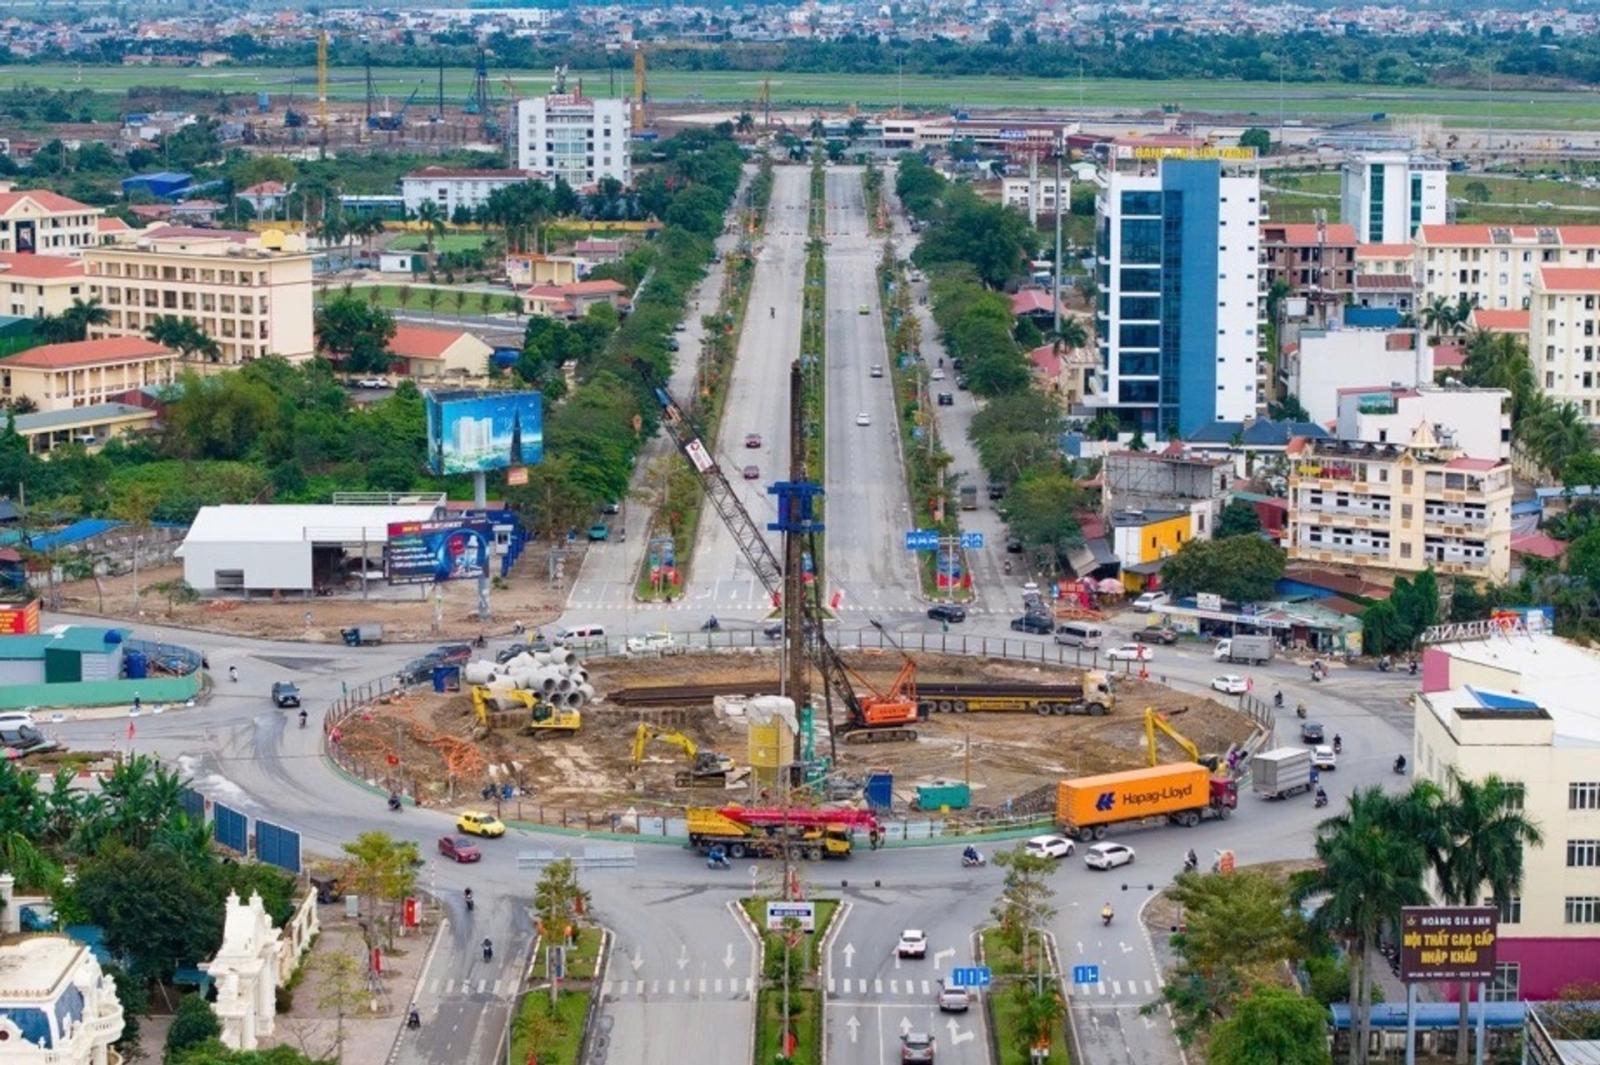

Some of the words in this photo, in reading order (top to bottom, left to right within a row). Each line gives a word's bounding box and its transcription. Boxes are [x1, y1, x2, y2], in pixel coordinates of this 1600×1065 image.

[1123, 784, 1192, 805] Hapag-Lloyd
[1422, 916, 1452, 926] HOÀNG
[1454, 916, 1470, 926] GIA
[1424, 929, 1449, 946] THẤT
[1451, 934, 1472, 946] CAO
[1474, 928, 1495, 946] CẤP
[1421, 949, 1448, 965] NHẬP
